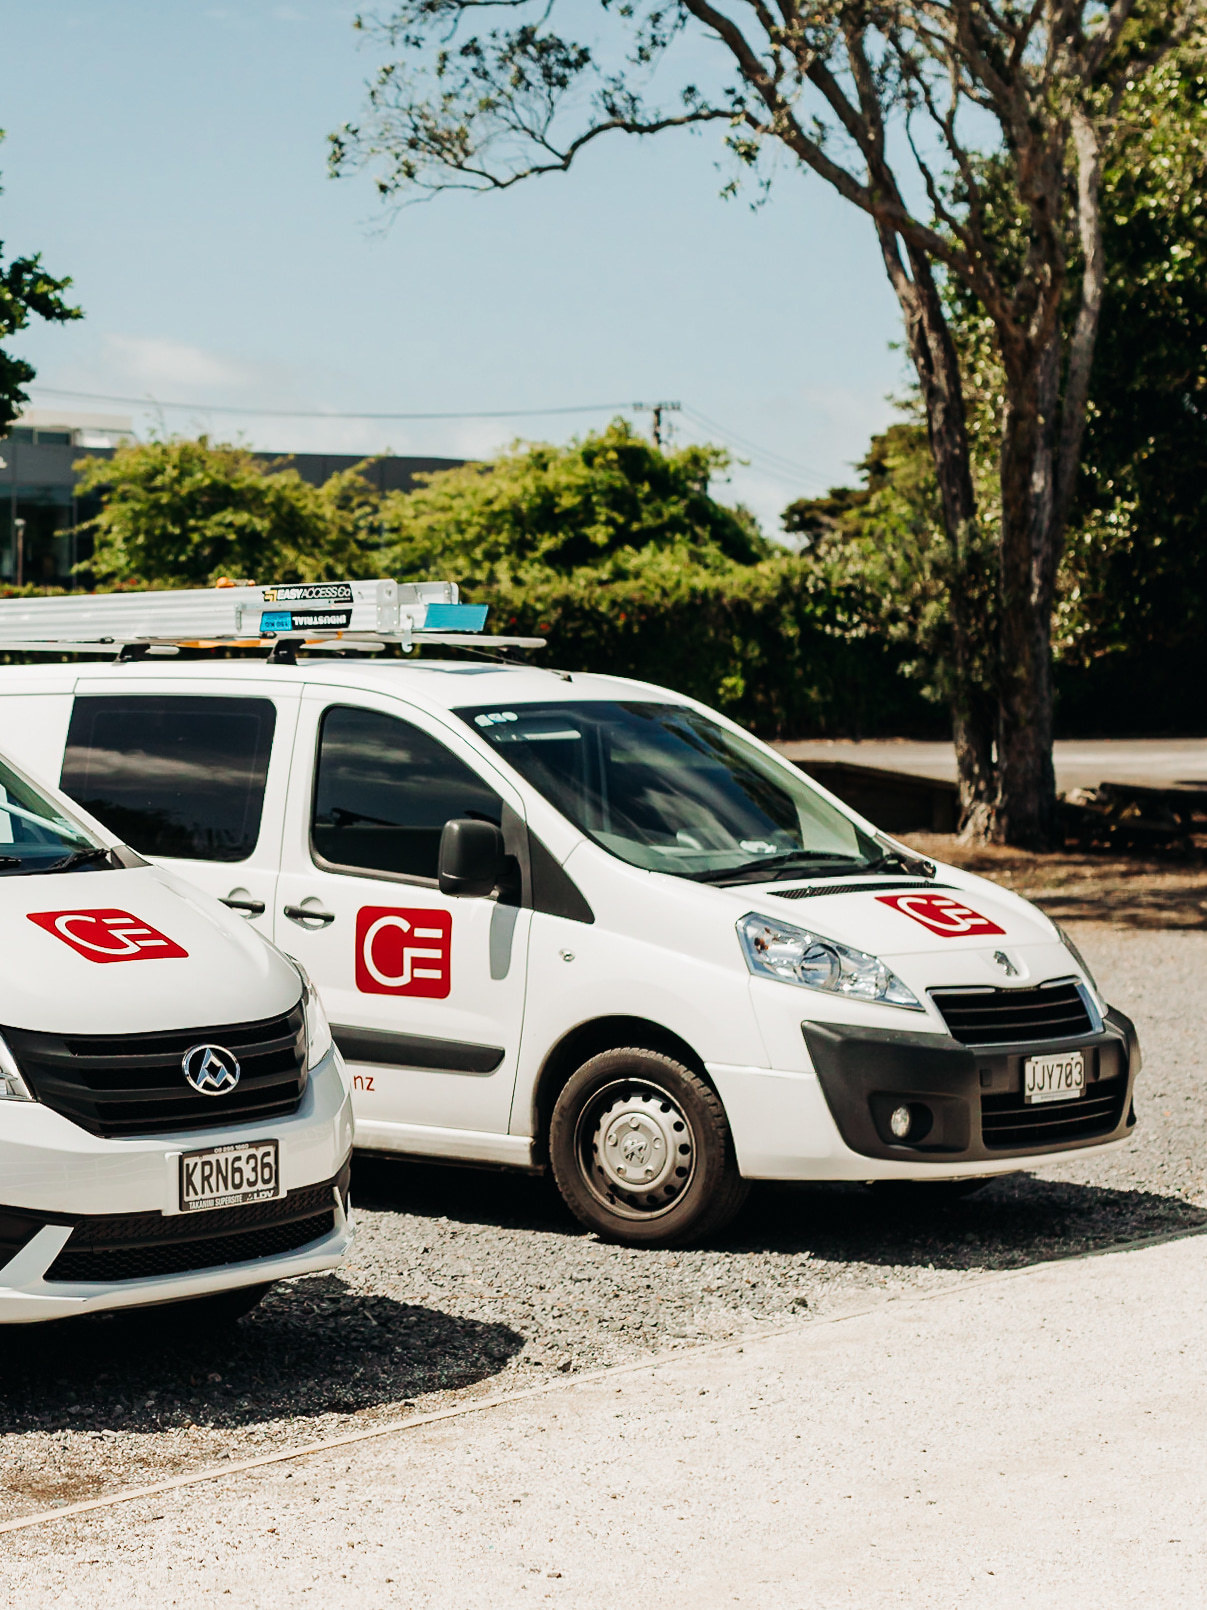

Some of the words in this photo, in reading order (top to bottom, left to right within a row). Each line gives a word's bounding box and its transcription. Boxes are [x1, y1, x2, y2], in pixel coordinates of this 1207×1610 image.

[292, 614, 347, 626] INDUSTRIAL
[1027, 1061, 1083, 1092] JJY703
[185, 1150, 274, 1197] KRN636
[253, 1189, 274, 1201] LDV
